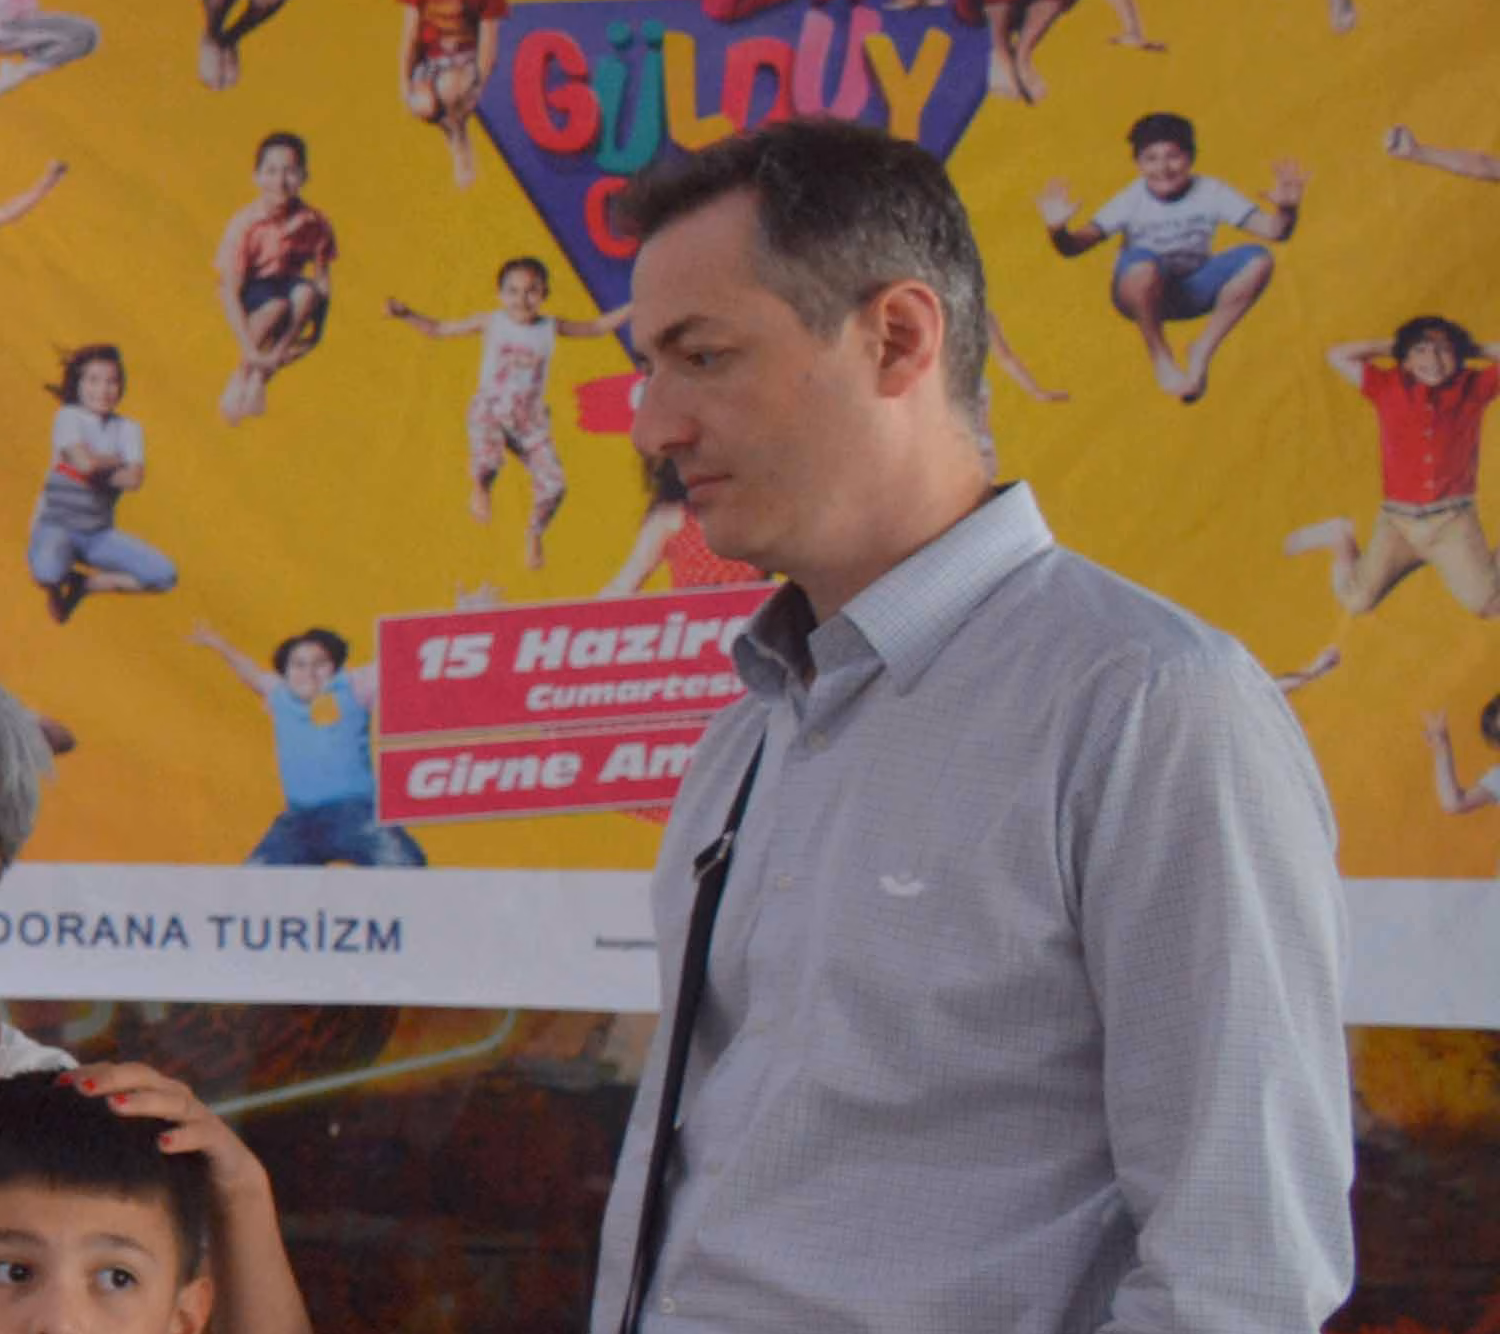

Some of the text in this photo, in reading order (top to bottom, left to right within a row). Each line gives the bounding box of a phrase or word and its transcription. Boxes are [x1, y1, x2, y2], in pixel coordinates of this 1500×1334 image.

[418, 633, 494, 681] 15
[407, 753, 581, 799] Girne
[206, 910, 402, 954] TURİZM
